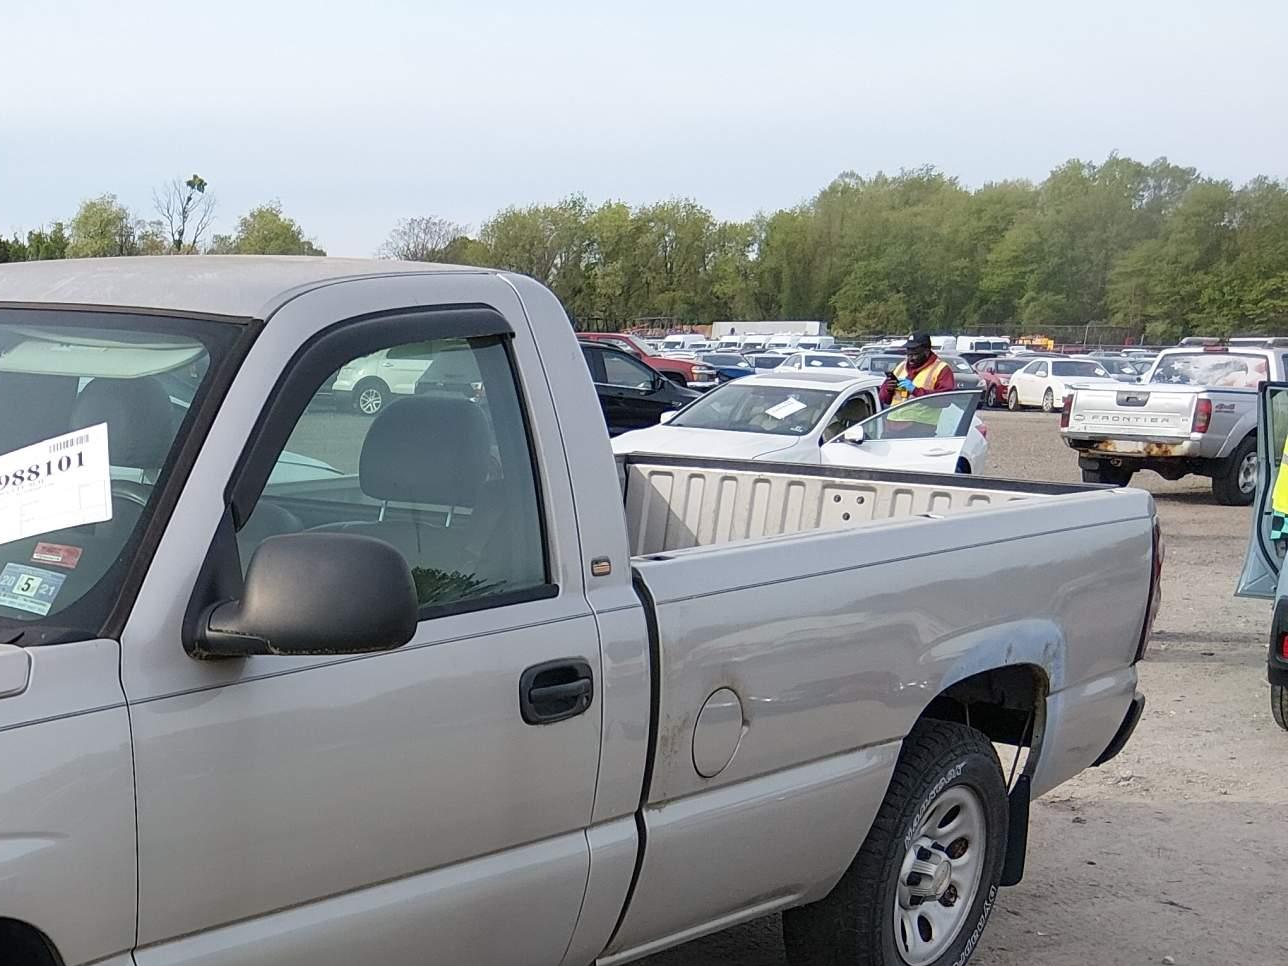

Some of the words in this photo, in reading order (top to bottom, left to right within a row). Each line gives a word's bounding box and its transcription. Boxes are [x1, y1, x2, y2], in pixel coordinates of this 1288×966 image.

[1091, 415, 1170, 423] FRONTIER
[0, 575, 16, 586] 20
[21, 577, 34, 592] 5
[39, 584, 55, 596] 21
